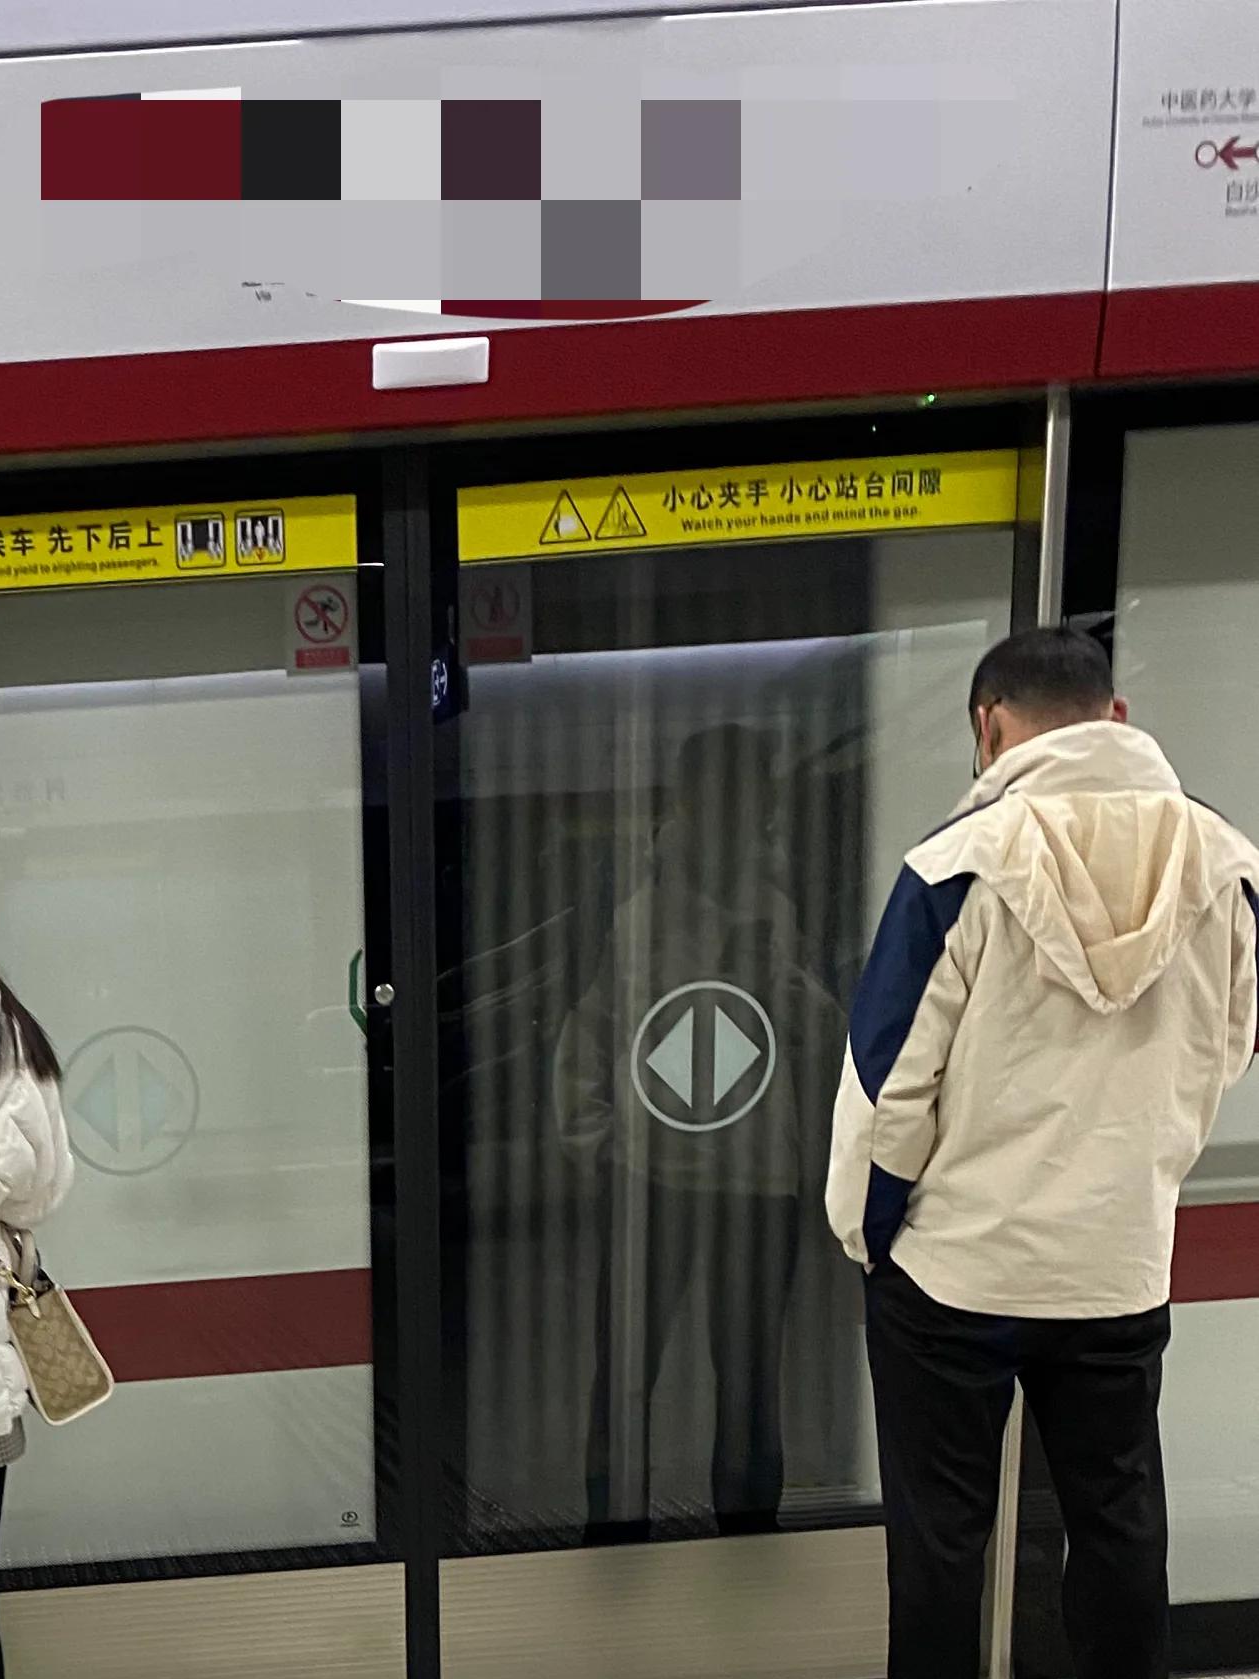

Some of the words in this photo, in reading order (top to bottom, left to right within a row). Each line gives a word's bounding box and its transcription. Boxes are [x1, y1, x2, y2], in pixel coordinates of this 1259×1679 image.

[662, 478, 769, 512] 小心夹手
[780, 467, 942, 504] 小心站台间隙
[48, 518, 164, 555] 先下后上
[681, 516, 723, 532] Watch
[727, 515, 757, 531] your
[760, 512, 801, 527] hands
[804, 508, 830, 523] and
[833, 506, 866, 520] mind
[868, 505, 890, 518] the
